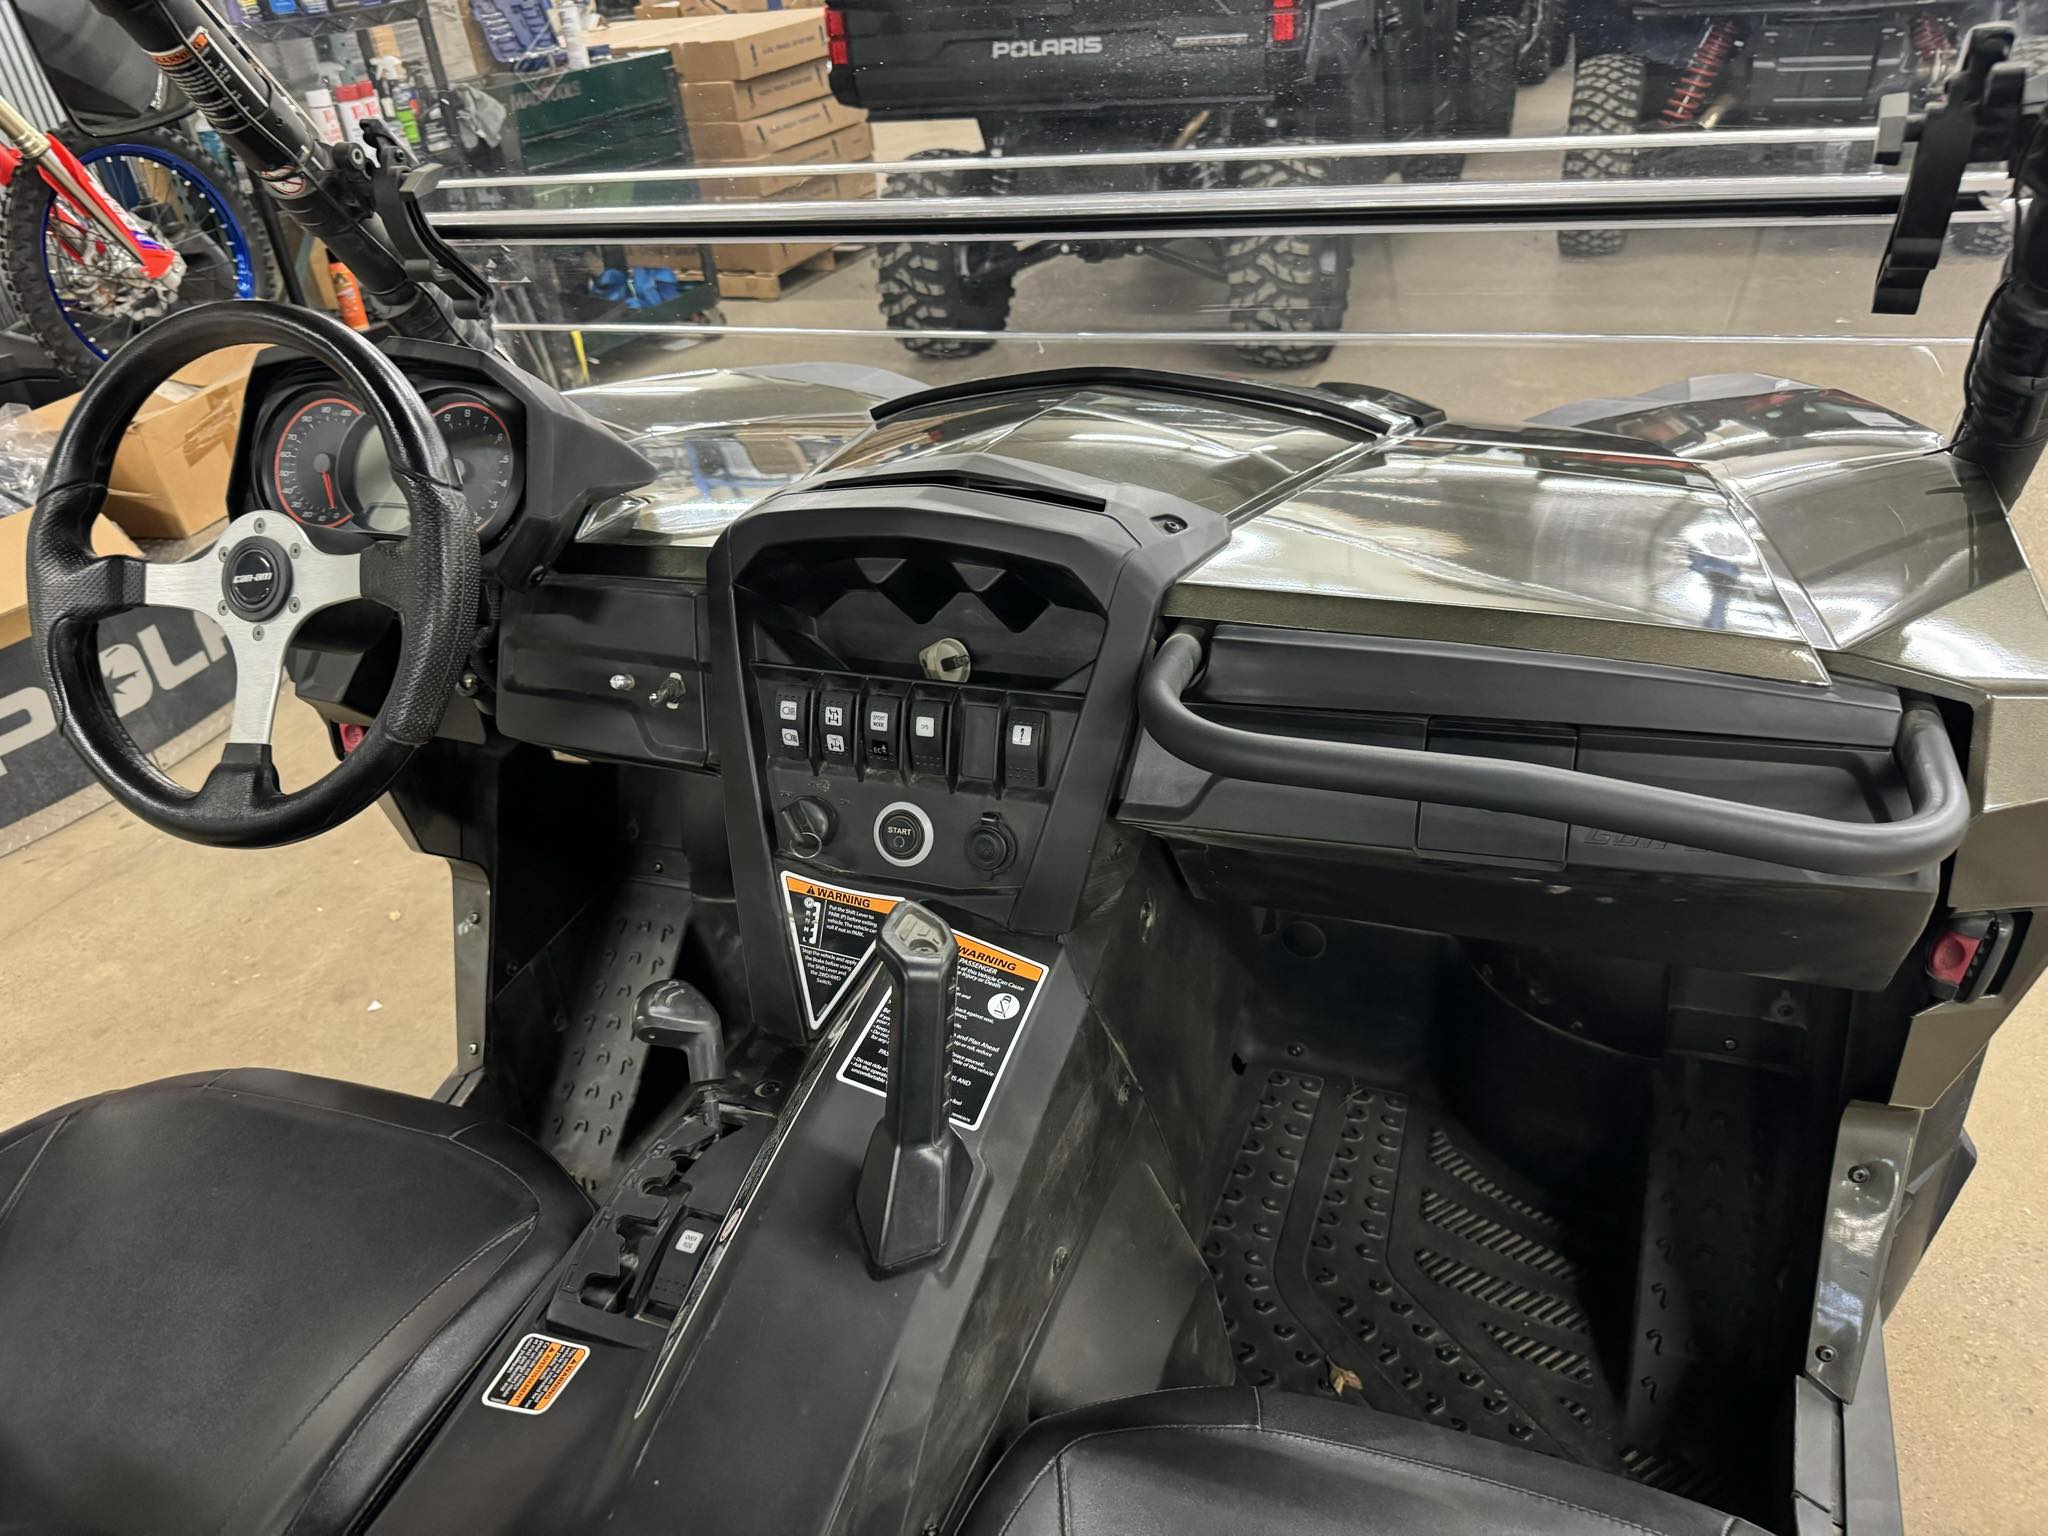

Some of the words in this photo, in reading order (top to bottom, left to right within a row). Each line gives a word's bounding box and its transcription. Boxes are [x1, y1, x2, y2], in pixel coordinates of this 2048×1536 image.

[992, 36, 1103, 58] POLARIS
[444, 413, 452, 422] 9
[464, 410, 471, 418] 8
[232, 572, 272, 584] can-am
[888, 826, 912, 836] START
[818, 888, 870, 908] WARNING
[959, 958, 998, 975] PASSENGER
[961, 971, 978, 981] Injury
[985, 979, 1001, 988] Death
[977, 971, 996, 982] Vehicle
[1008, 982, 1024, 991] Cause
[968, 1037, 980, 1045] Plan
[980, 1042, 1000, 1052] Ahead
[956, 1077, 972, 1086] AND
[684, 1234, 698, 1242] OVER
[514, 1355, 550, 1402] AVERTISSEMENT
[544, 1364, 572, 1400] WARNING
